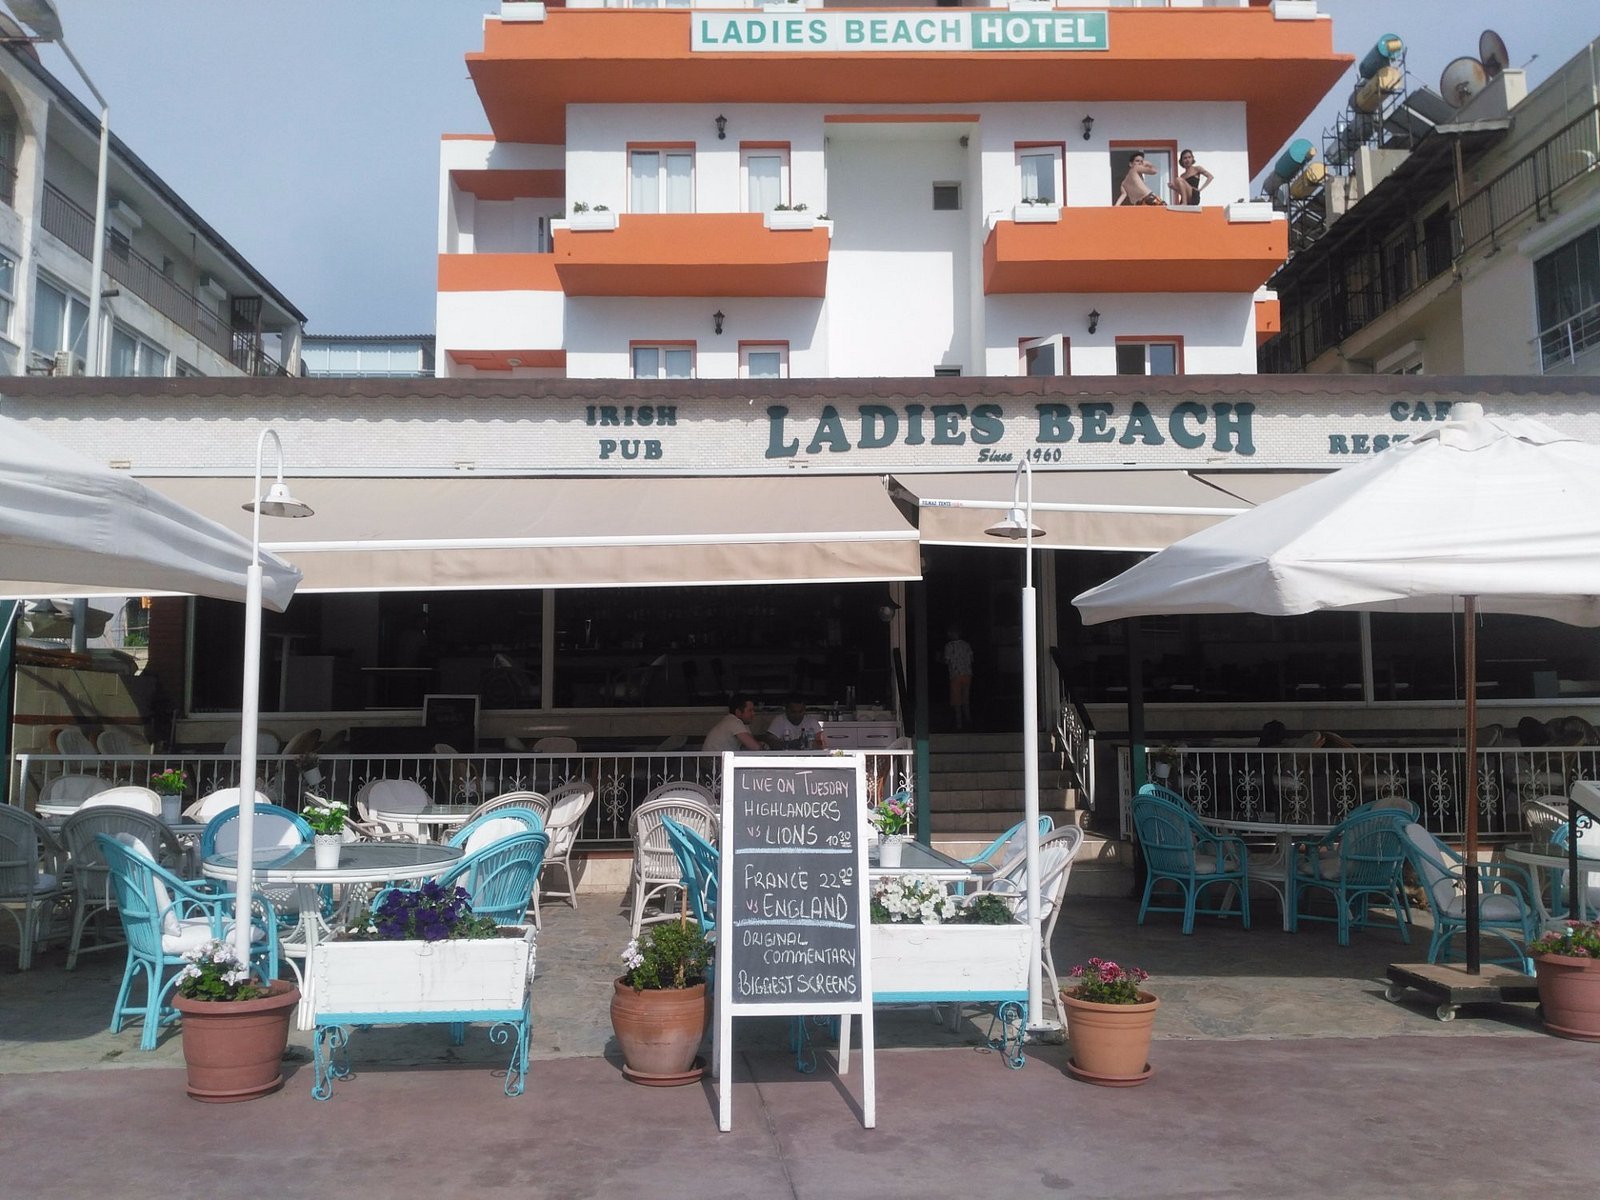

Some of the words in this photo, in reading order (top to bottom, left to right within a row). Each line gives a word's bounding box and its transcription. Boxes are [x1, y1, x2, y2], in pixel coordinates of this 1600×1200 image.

[701, 19, 828, 44] LADIES
[844, 18, 962, 44] BEACH
[981, 17, 1097, 43] HOTEL
[586, 405, 678, 427] IRISH
[765, 404, 1005, 459] LADIES
[1035, 402, 1256, 456] BEACH
[599, 439, 664, 460] PUB
[978, 448, 1013, 463] Since
[1026, 448, 1062, 463] 1960
[741, 773, 773, 792] LIVE
[777, 778, 796, 795] ON
[795, 770, 849, 798] TUESDAY
[744, 800, 841, 822] HIGHLANDERS
[766, 823, 818, 845] LIONS
[744, 864, 808, 890] FRANCE
[763, 893, 848, 920] ENGLAND
[743, 930, 808, 947] ORIGINAL
[763, 948, 856, 967] COMMENTARY
[739, 969, 794, 995] BIGGEST
[797, 973, 857, 994] SCREENS
